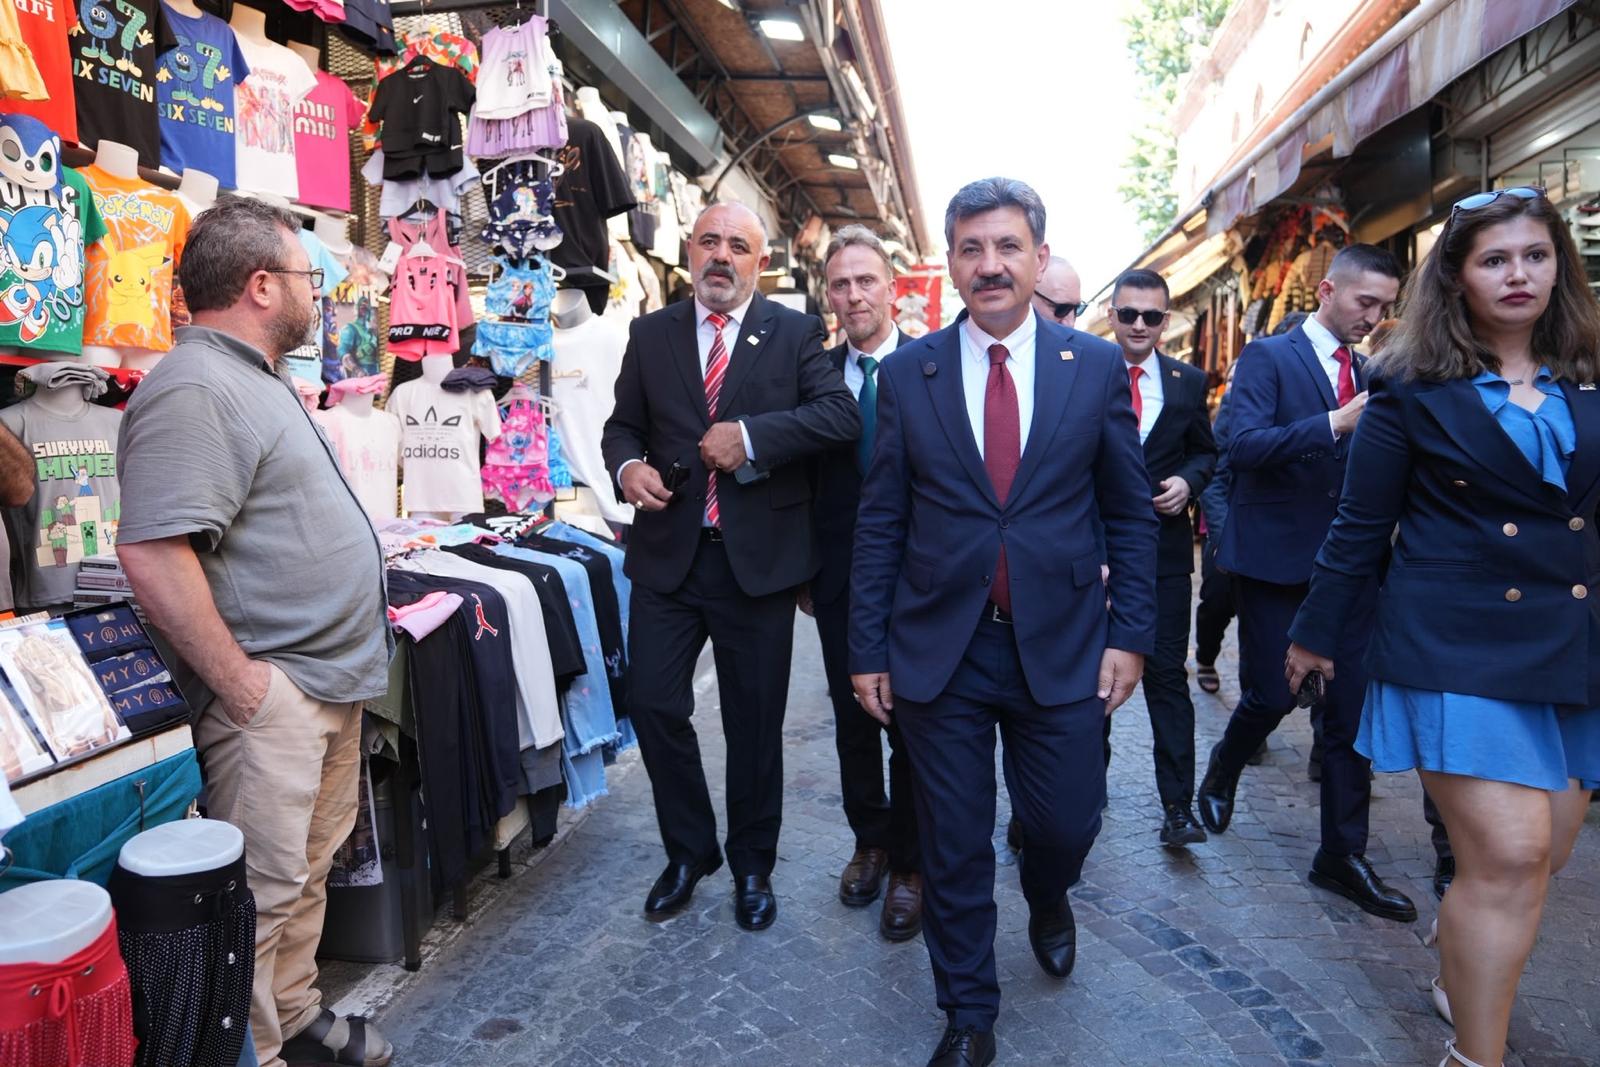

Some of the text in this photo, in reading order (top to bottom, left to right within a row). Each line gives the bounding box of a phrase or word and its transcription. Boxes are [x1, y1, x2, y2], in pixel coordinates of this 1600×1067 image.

[73, 59, 154, 103] IX SEVEN
[158, 101, 234, 134] SIX SEVEN
[295, 116, 336, 140] miu
[389, 326, 414, 336] PRO
[32, 439, 114, 459] SURVIVAL
[404, 443, 461, 460] adidas
